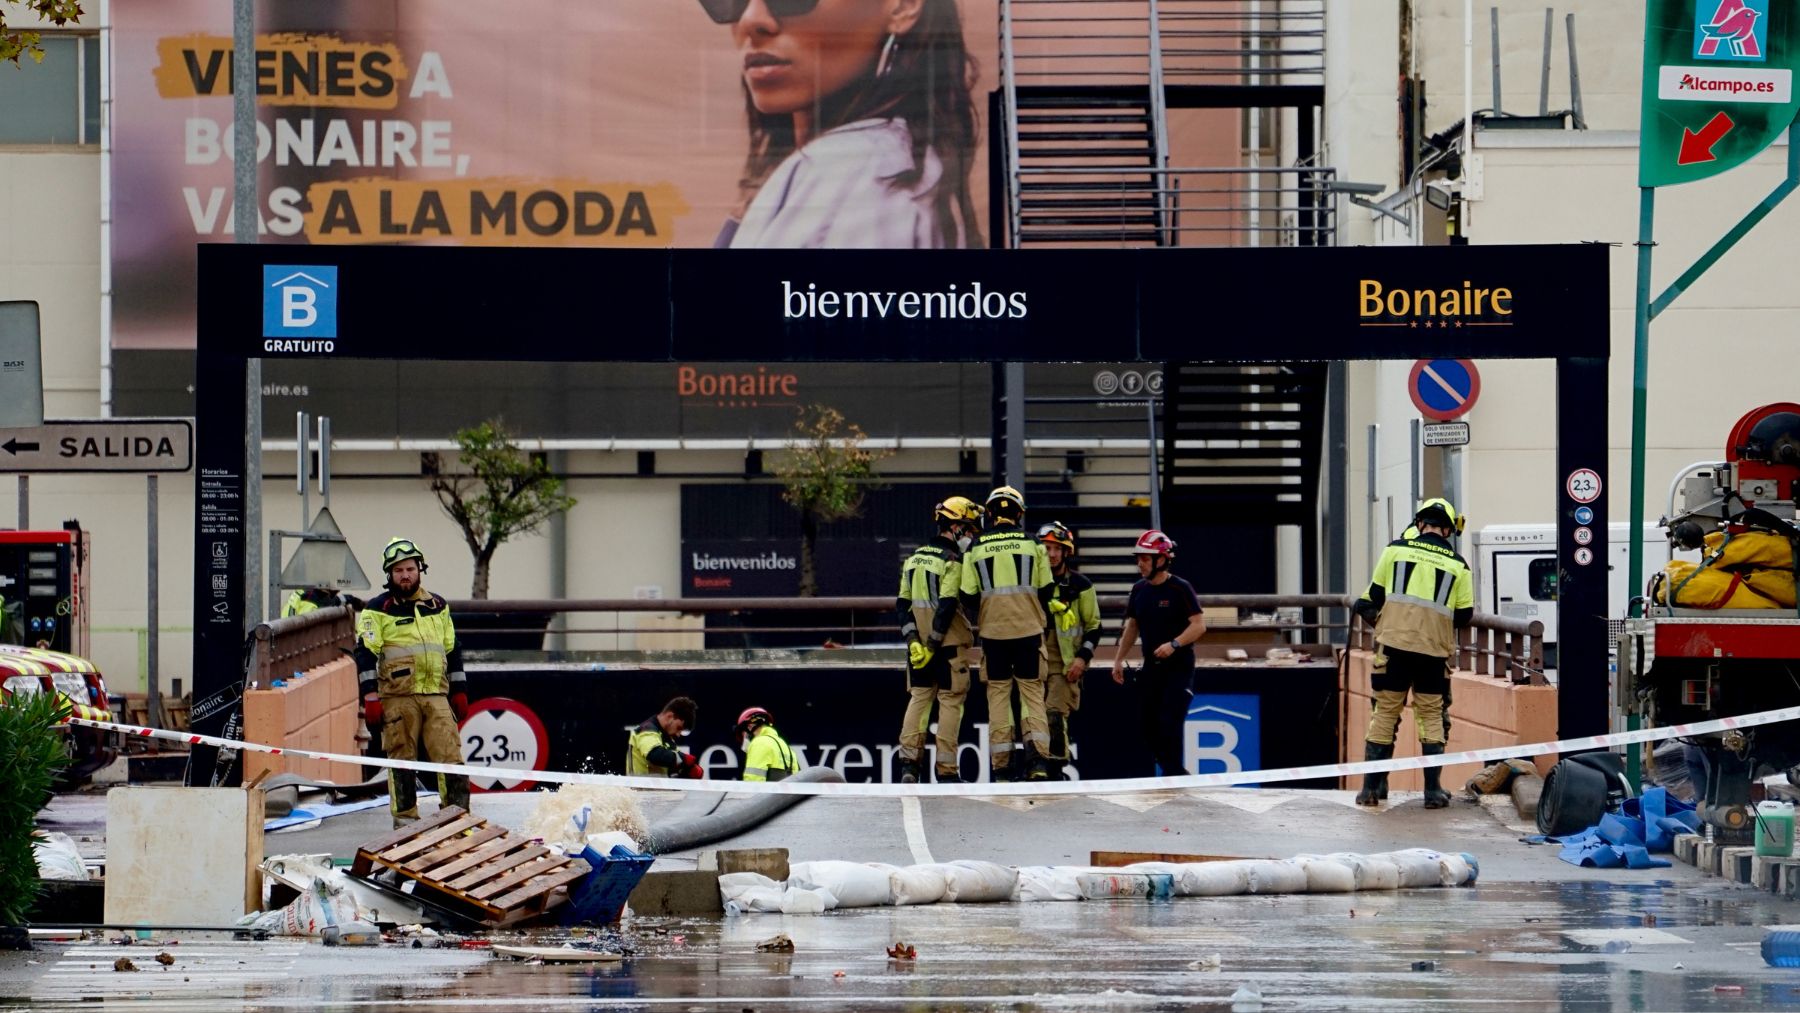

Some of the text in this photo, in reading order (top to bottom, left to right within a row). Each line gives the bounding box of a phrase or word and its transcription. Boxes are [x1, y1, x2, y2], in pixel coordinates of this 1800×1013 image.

[409, 51, 453, 98] A
[1679, 74, 1774, 94] Alcampo.es
[185, 118, 471, 176] BONAIRE,
[182, 186, 657, 236] VS A LA MODA
[283, 286, 317, 327] B
[781, 281, 1028, 319] bienvenidos
[1360, 280, 1513, 317] Bonaire
[264, 340, 334, 352] GRATUITO
[260, 382, 308, 396] aire.es
[679, 366, 798, 396] Bonaire
[59, 437, 175, 457] SALIDA
[1573, 479, 1597, 493] 2,3m
[980, 531, 1025, 543] Bomberos
[985, 543, 1020, 553] Logroño
[1408, 541, 1454, 557] BOMBEROS
[692, 551, 796, 570] bienvenidos
[226, 712, 237, 740] naire
[466, 735, 526, 767] 2,3m
[1183, 720, 1242, 775] B
